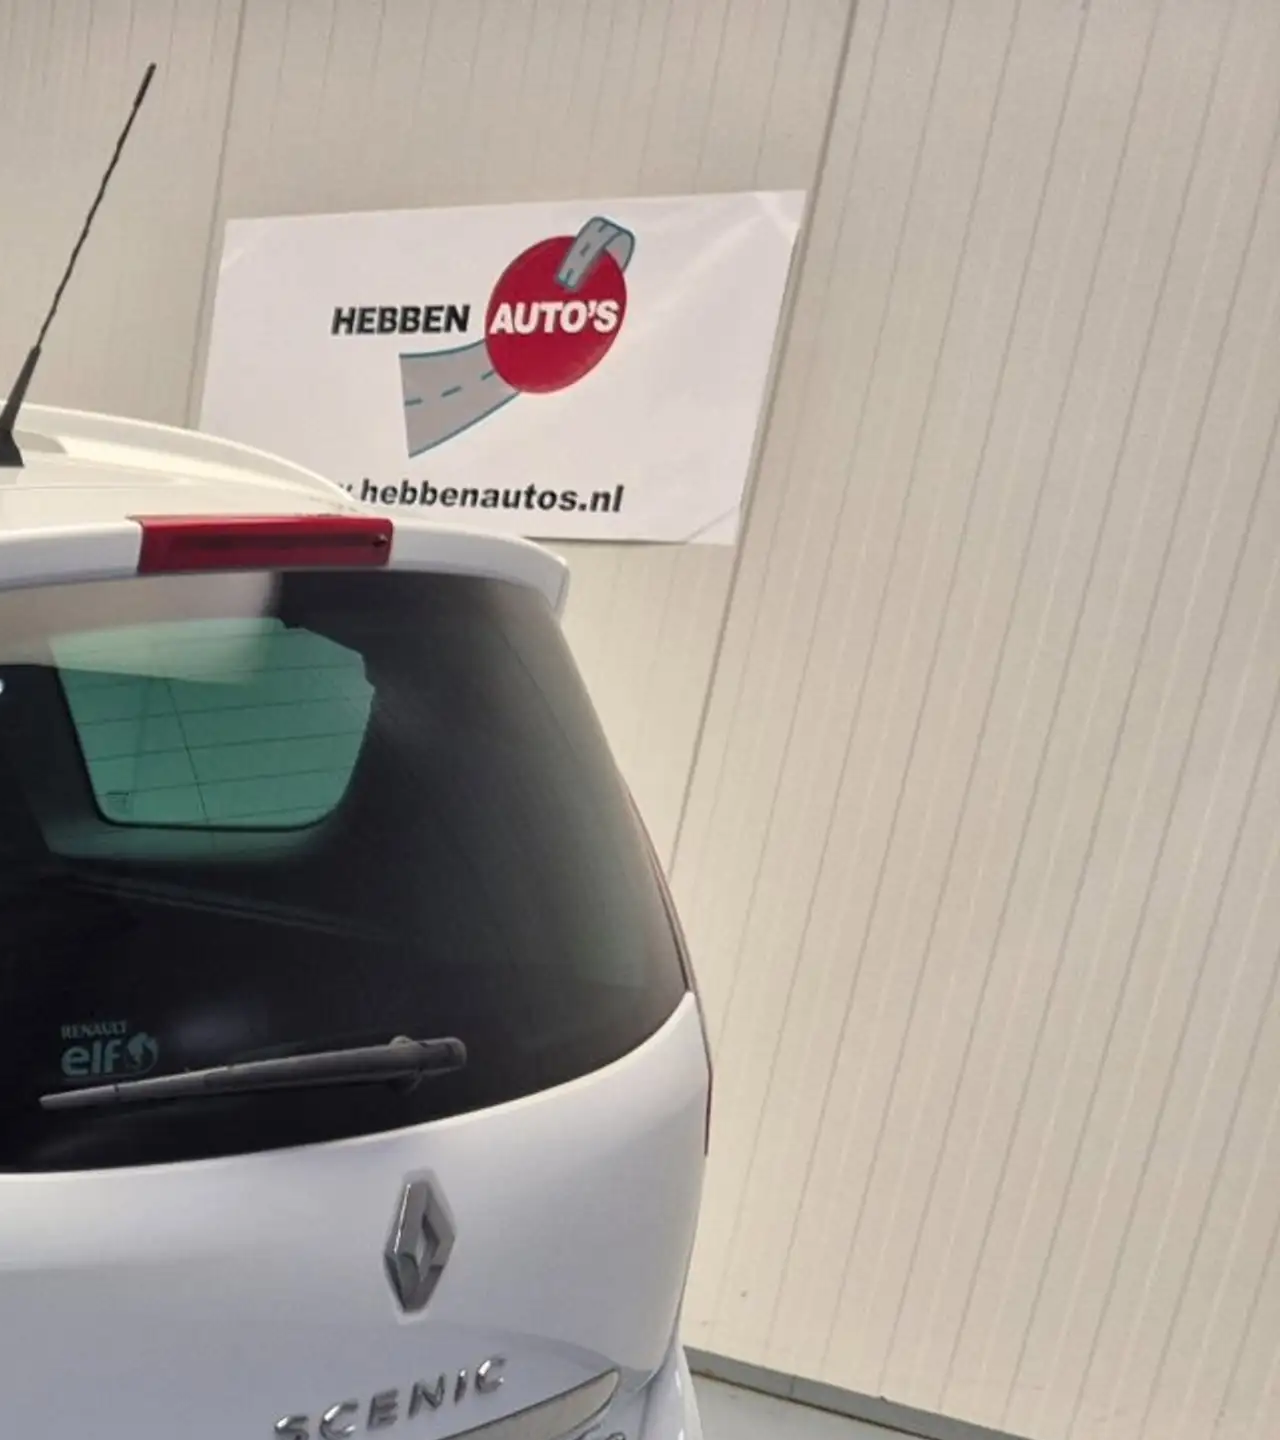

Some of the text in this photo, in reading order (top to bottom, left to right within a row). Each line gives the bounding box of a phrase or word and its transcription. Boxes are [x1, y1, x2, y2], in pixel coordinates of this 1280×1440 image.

[331, 299, 619, 335] HEBBEN AUTO'S
[340, 477, 624, 513] hebbenautos.nl
[60, 1020, 127, 1039] RENAULT
[61, 1040, 122, 1076] elf
